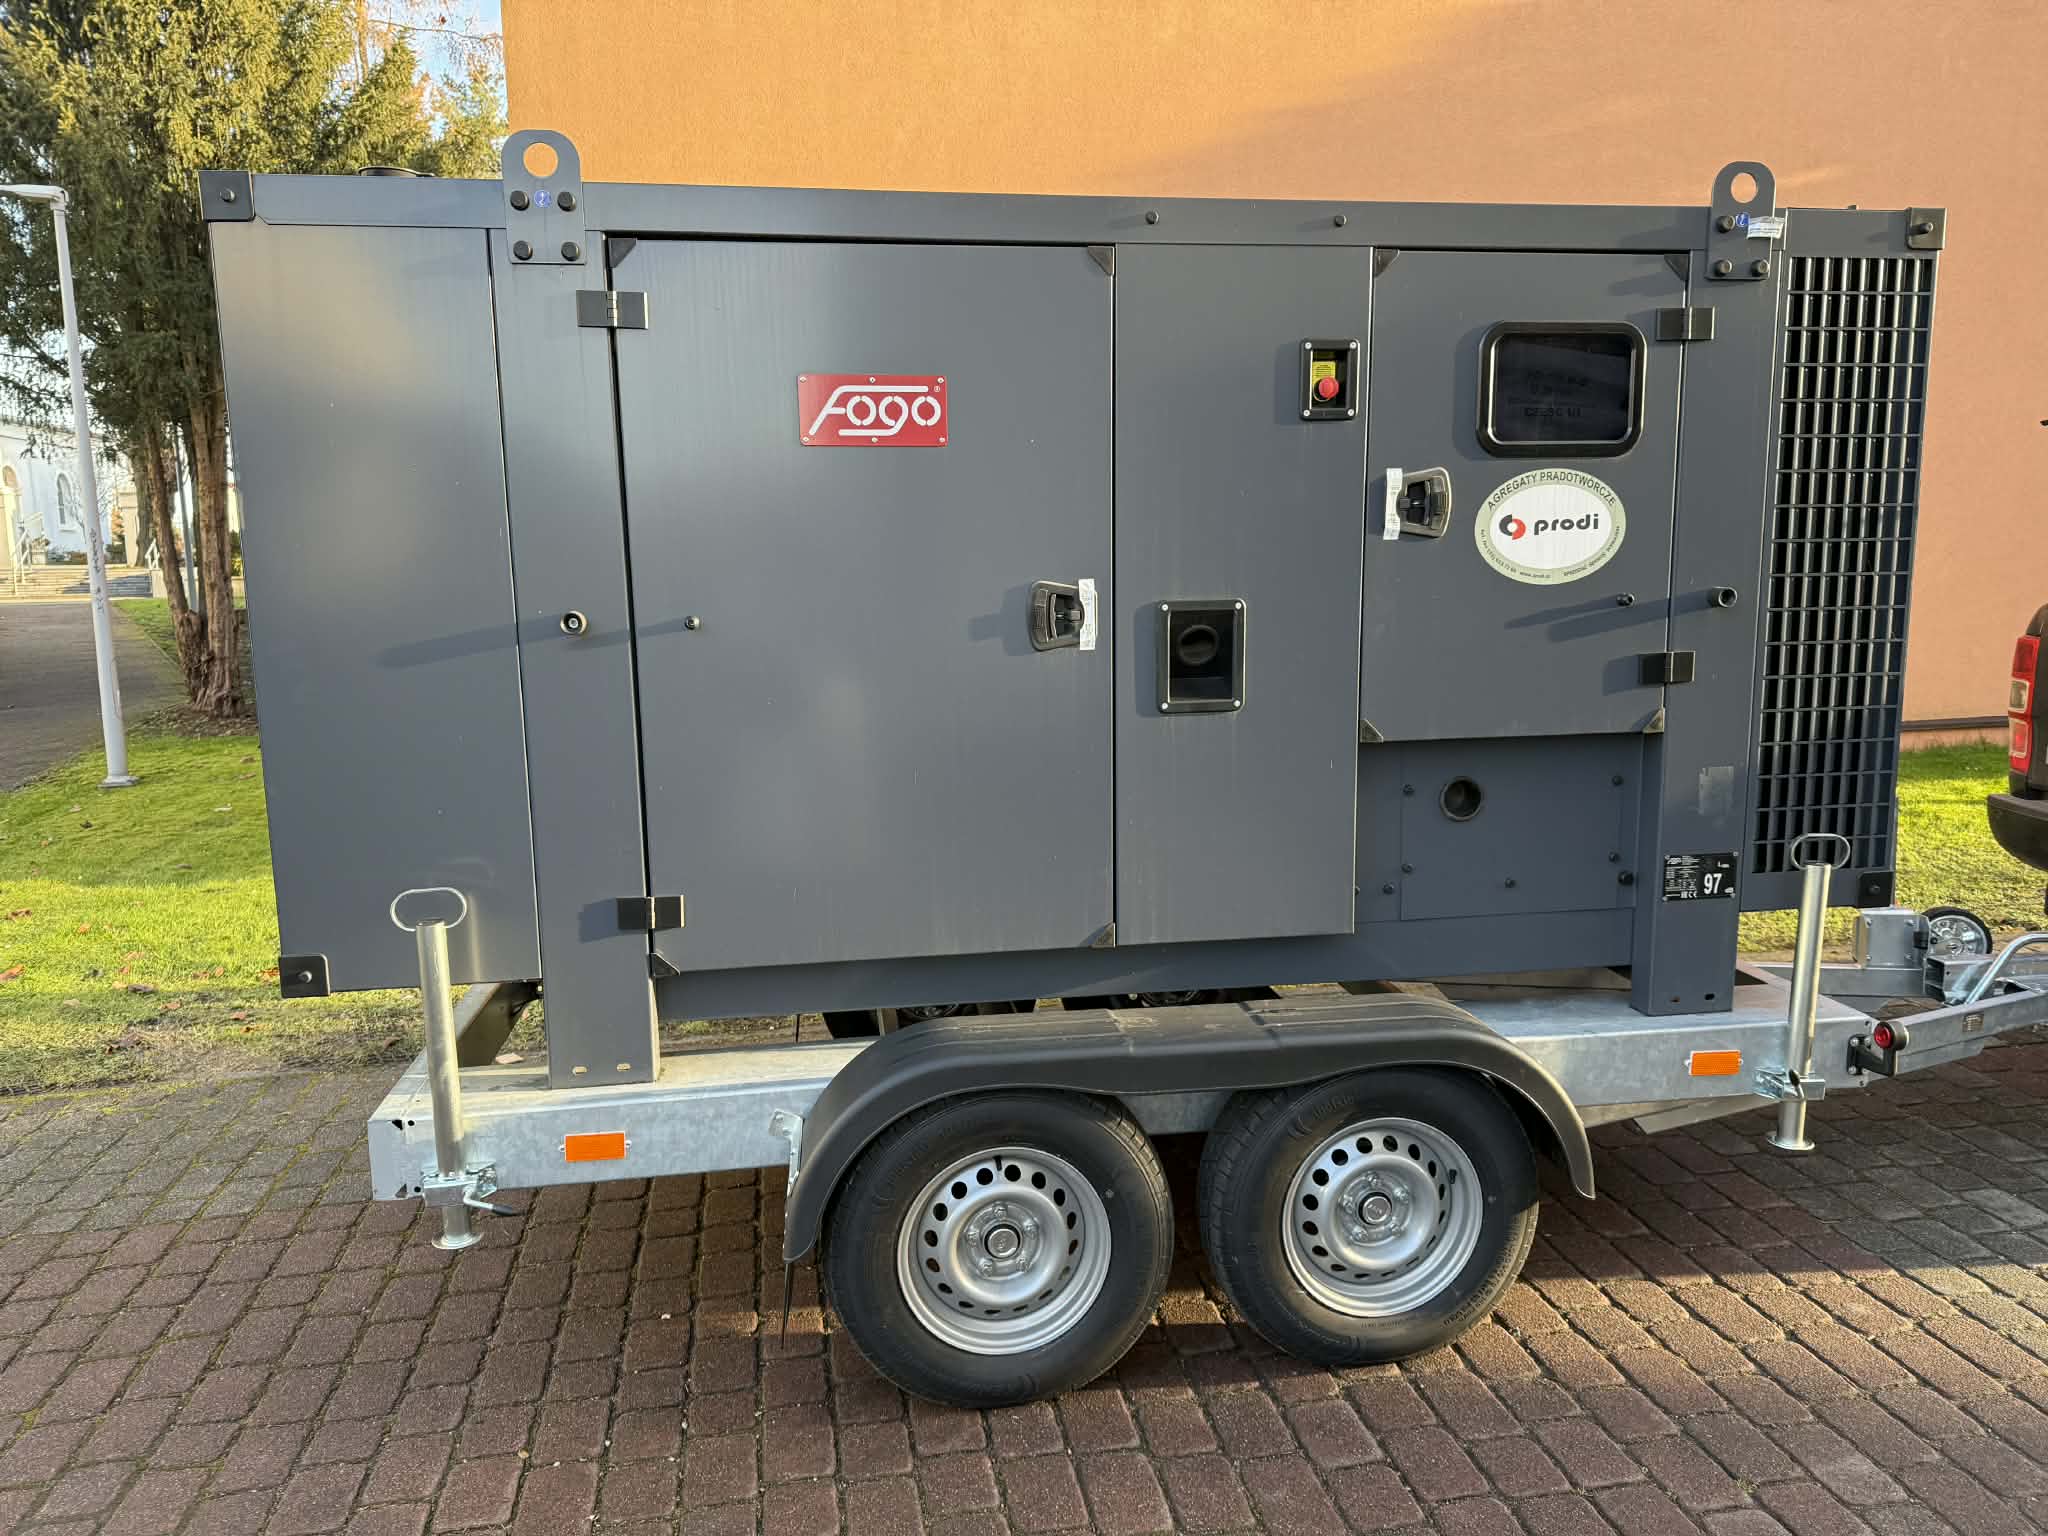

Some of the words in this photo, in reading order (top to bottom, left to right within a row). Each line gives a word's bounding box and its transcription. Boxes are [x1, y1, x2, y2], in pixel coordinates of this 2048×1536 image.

[1487, 473, 1538, 512] AGREGATY
[1533, 513, 1599, 536] prodi
[1703, 873, 1722, 895] 97
